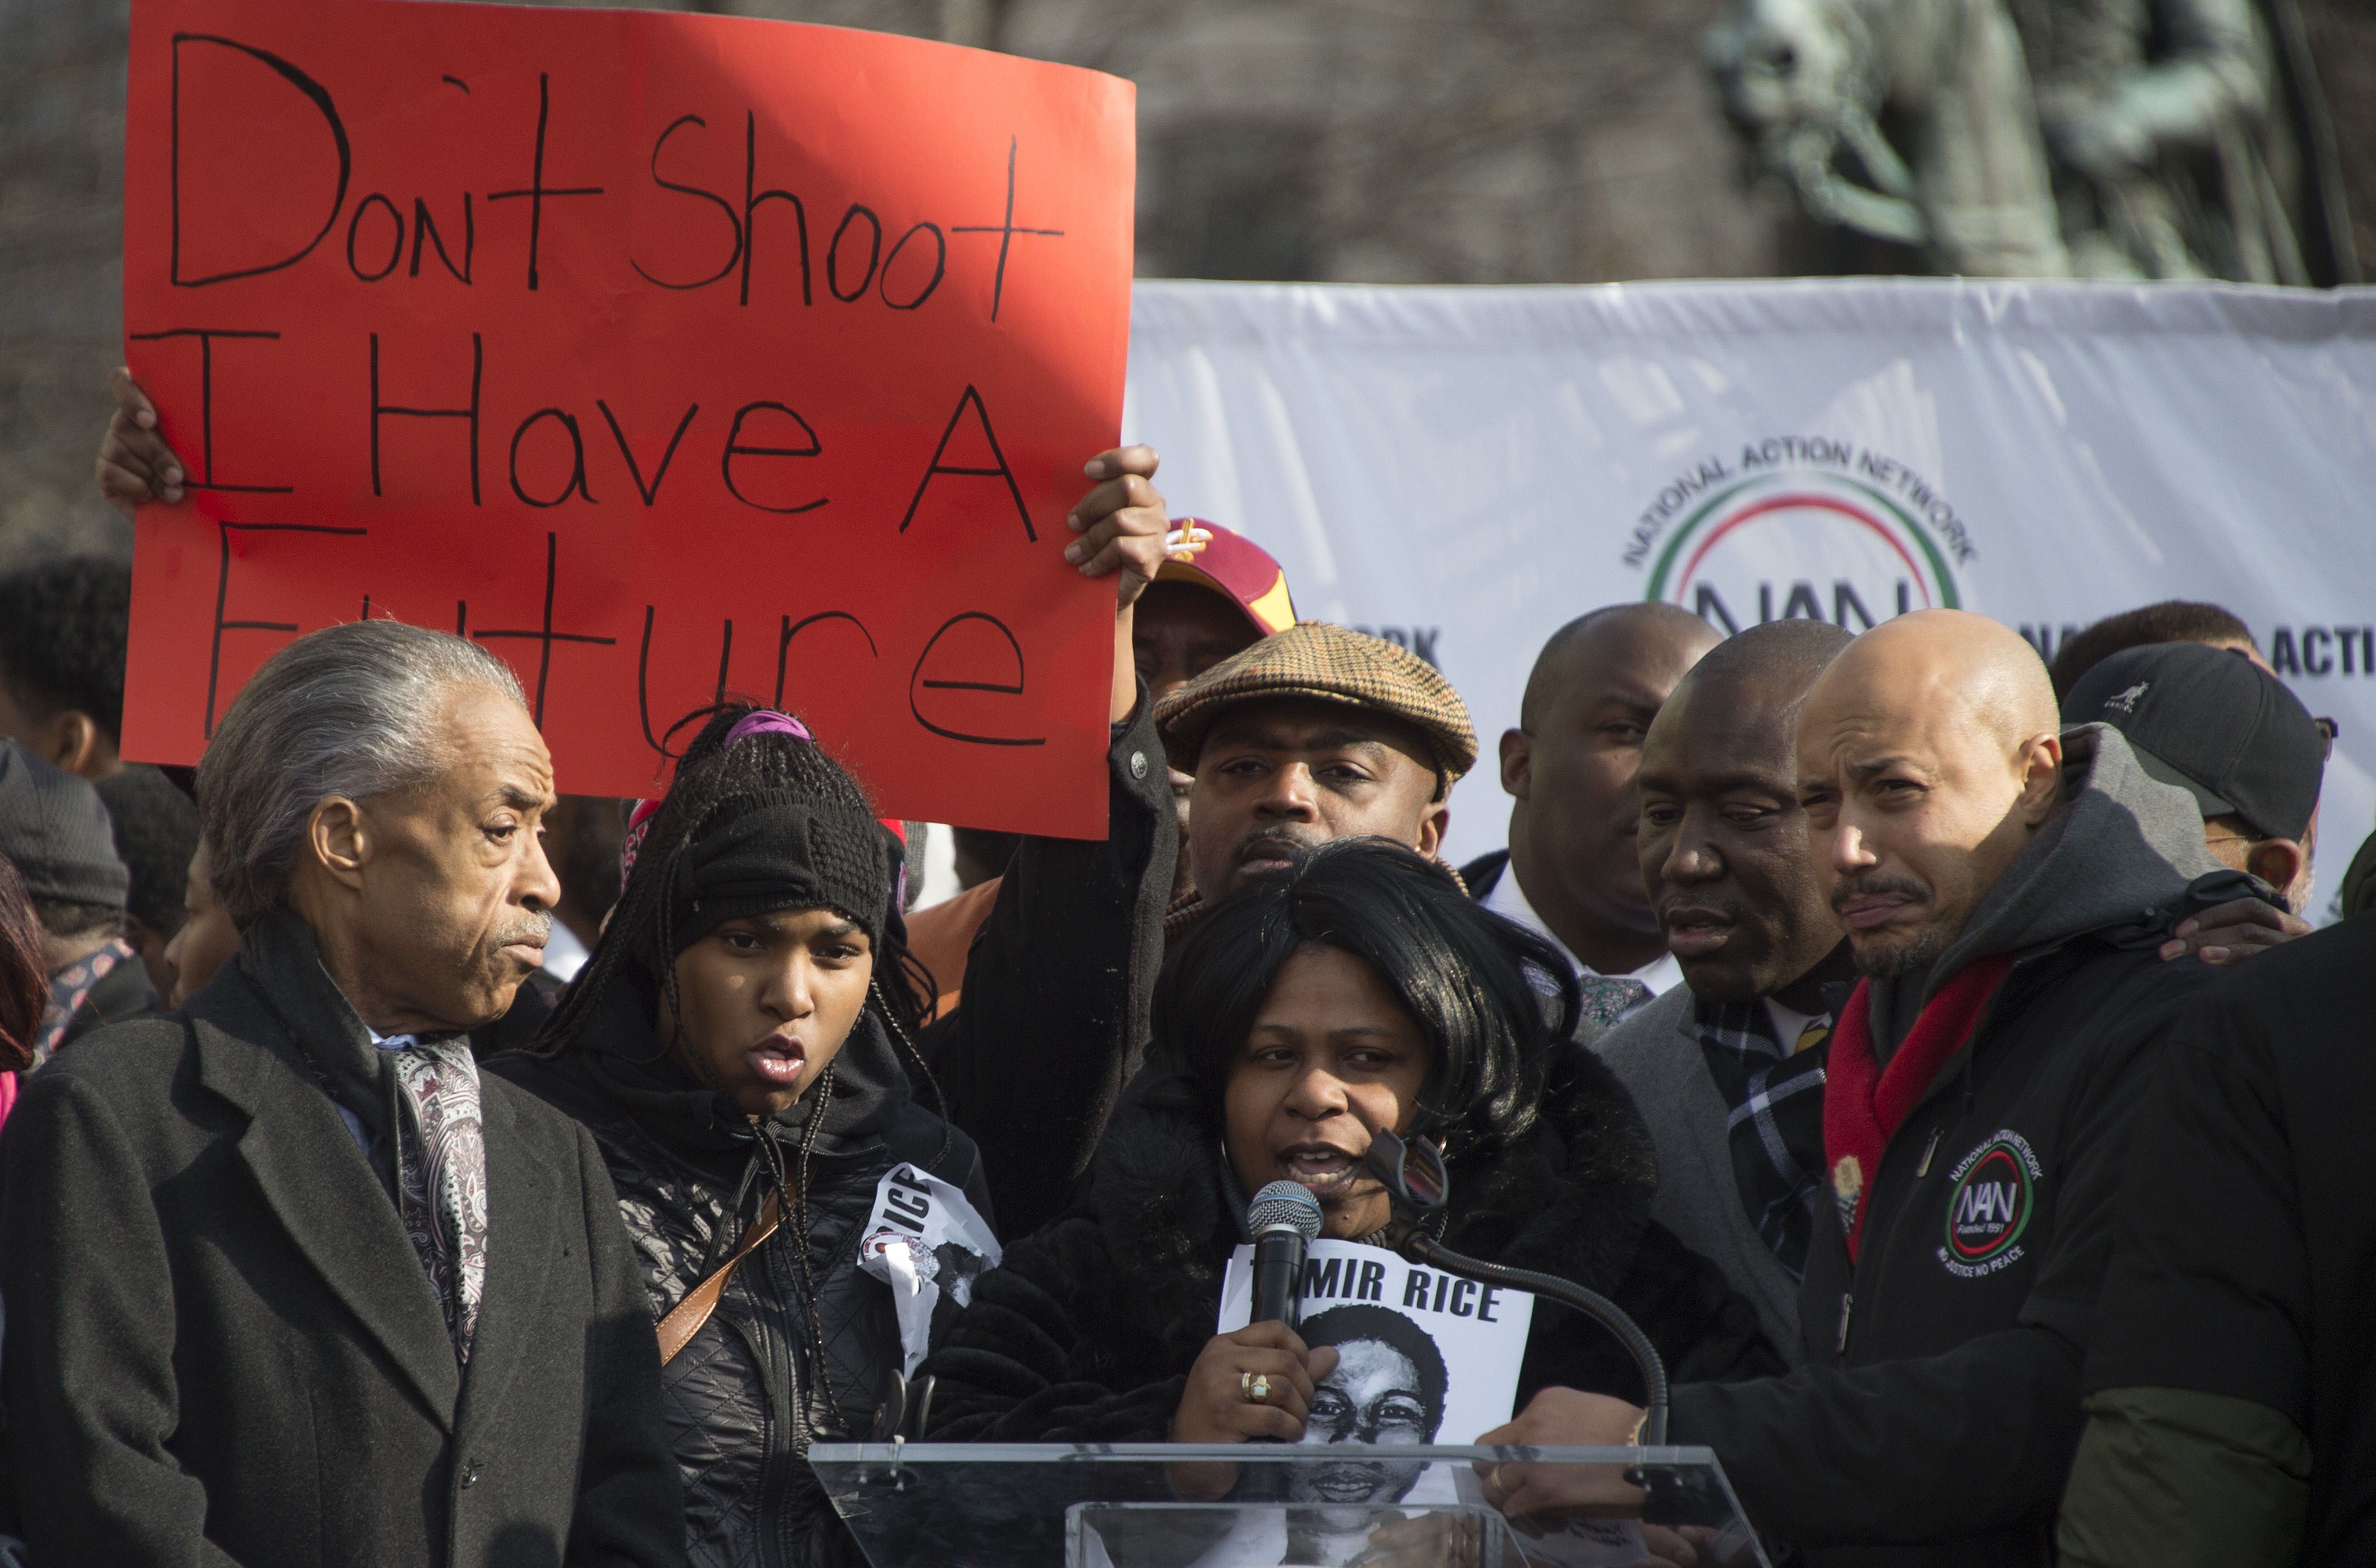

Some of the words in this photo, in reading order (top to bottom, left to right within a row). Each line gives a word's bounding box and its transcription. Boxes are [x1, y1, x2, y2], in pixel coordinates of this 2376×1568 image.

[631, 108, 1064, 323] Shoot
[130, 329, 294, 492] I
[370, 331, 829, 513] Have
[899, 383, 1037, 542] A
[1621, 455, 1735, 567] NATIONAL
[1741, 435, 1851, 470] ACTION
[1859, 447, 1978, 566] NETWORK
[205, 520, 1046, 757] Fture
[2272, 624, 2376, 677] ACTI
[1949, 1138, 1992, 1182] NATIONAL
[2013, 1132, 2043, 1180] NETWORK
[876, 1167, 932, 1240] ICE
[1956, 1181, 2017, 1223] NAN
[1250, 1258, 1386, 1302] MIR
[1402, 1269, 1504, 1323] RICE
[1945, 1260, 1974, 1277] JUSTICE
[1975, 1263, 1989, 1277] NO
[1990, 1245, 2025, 1272] PEACE
